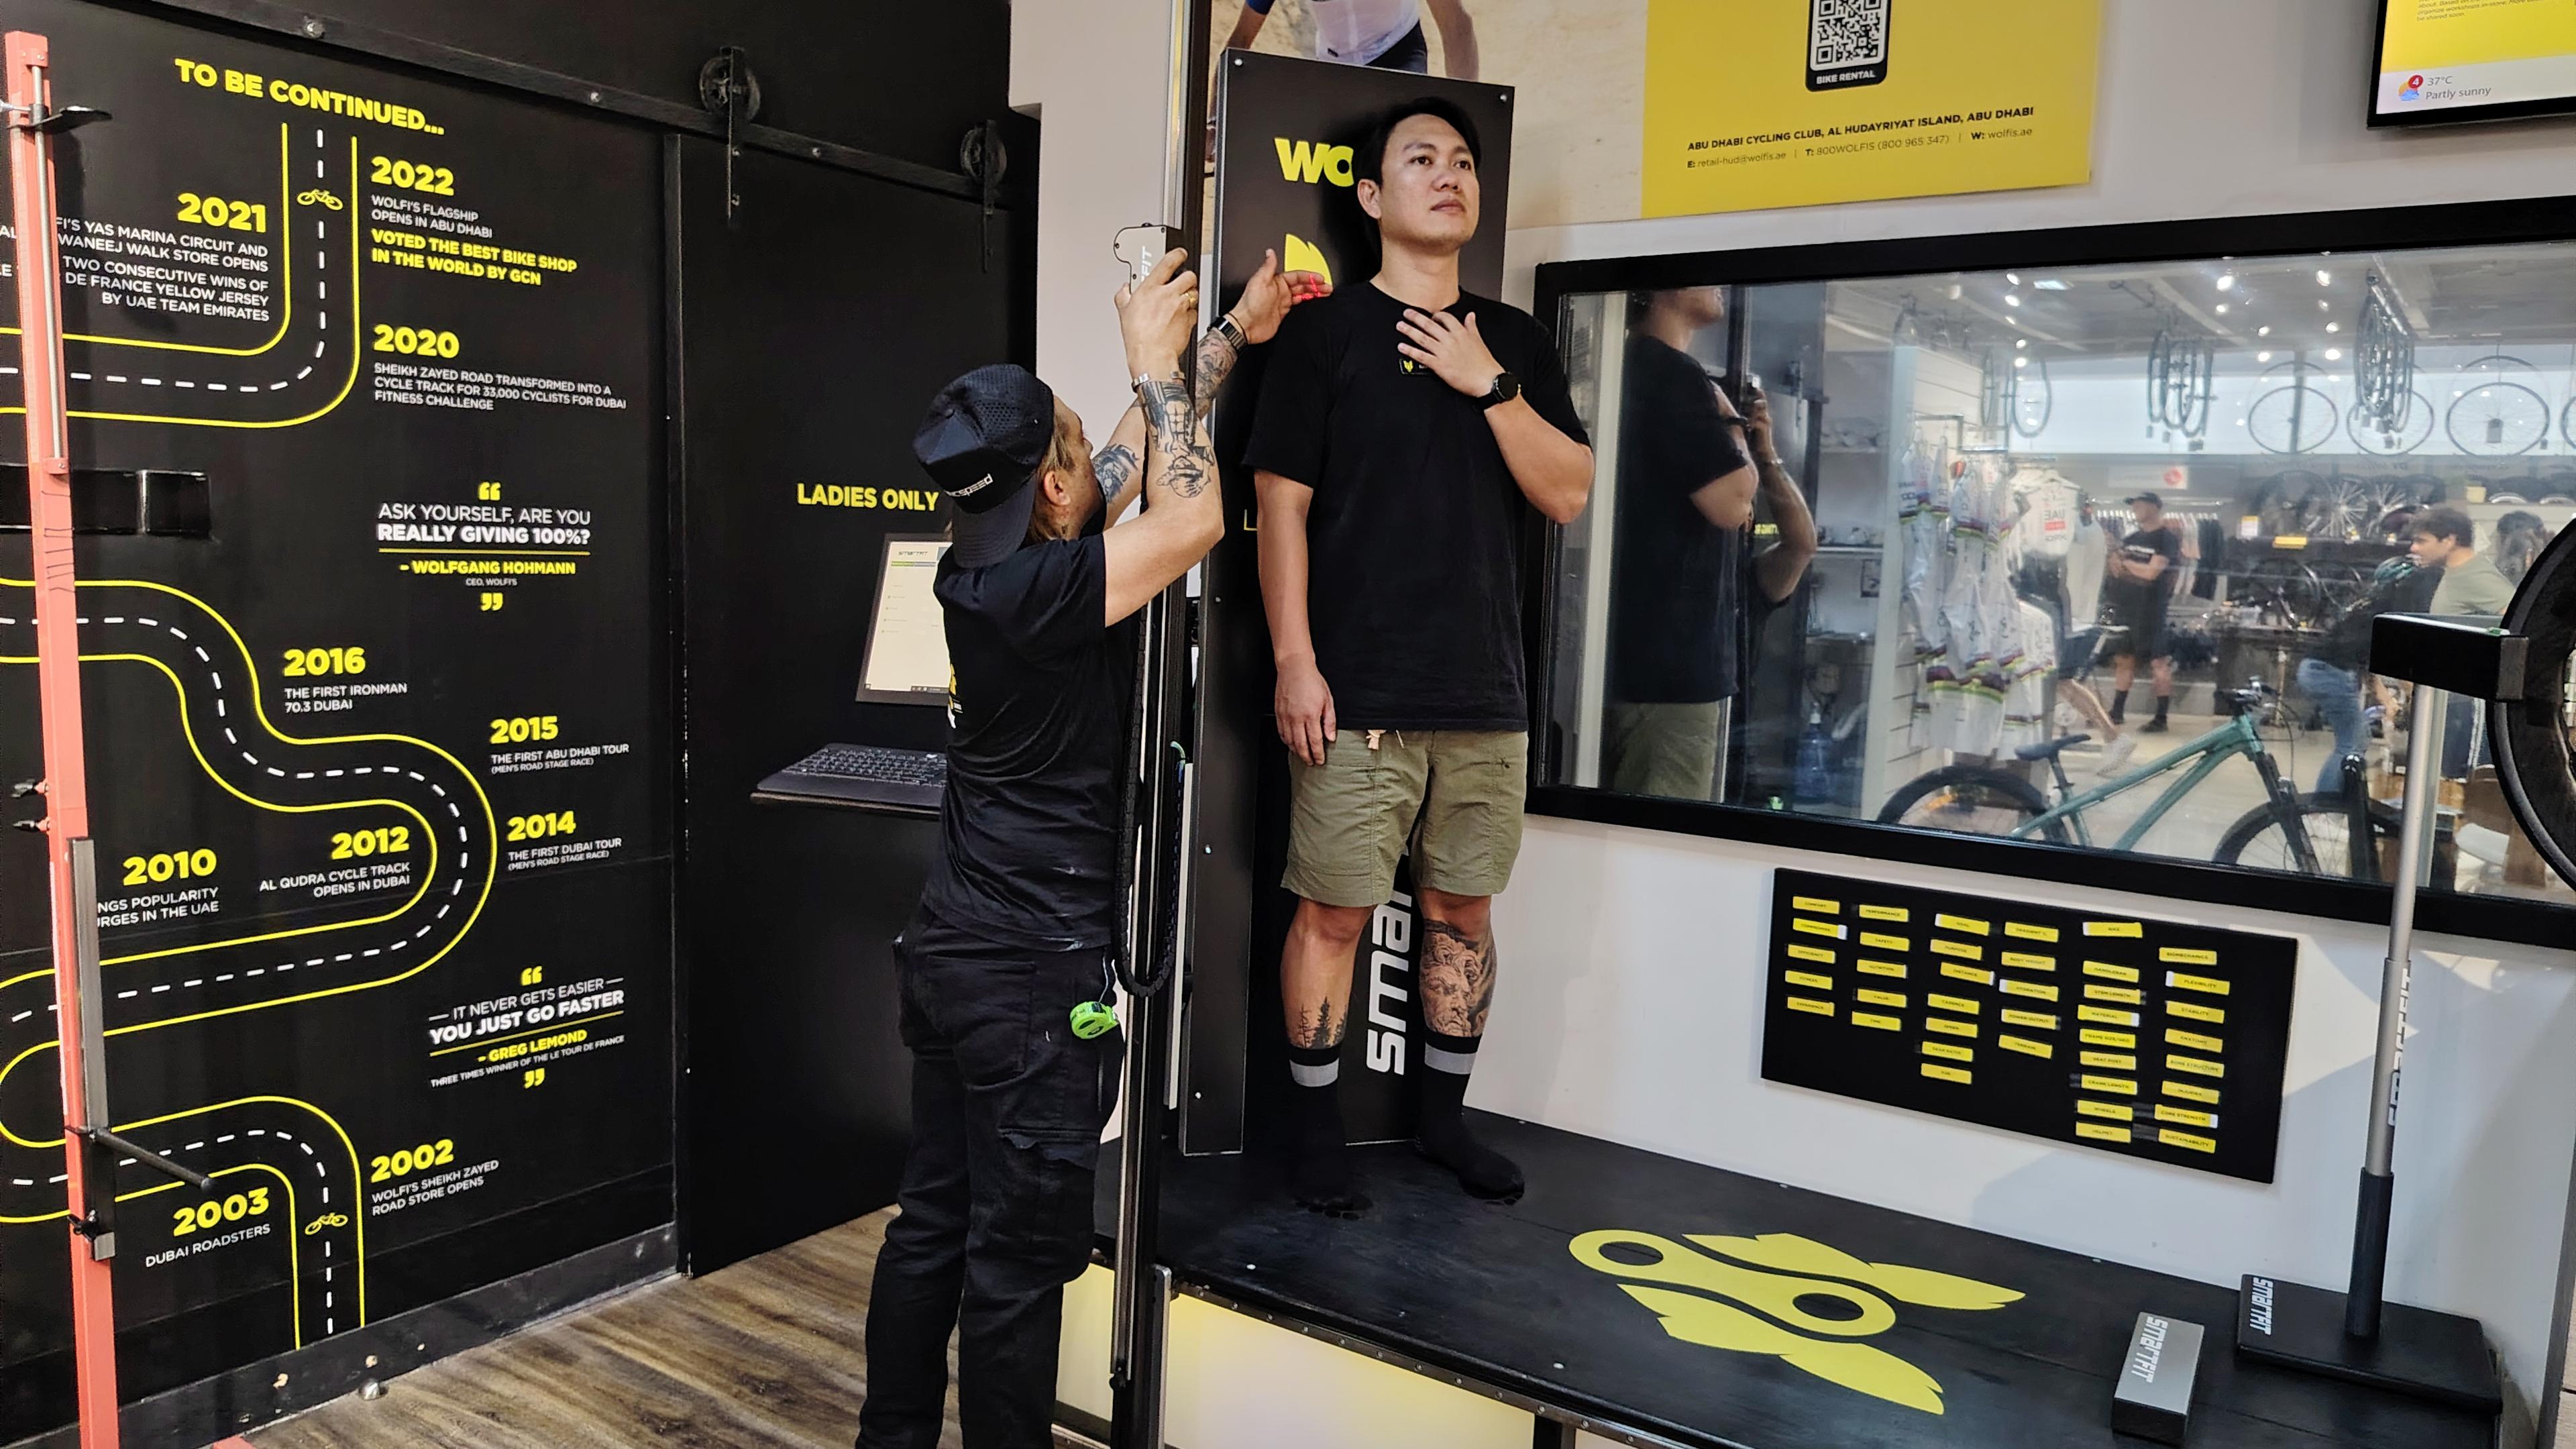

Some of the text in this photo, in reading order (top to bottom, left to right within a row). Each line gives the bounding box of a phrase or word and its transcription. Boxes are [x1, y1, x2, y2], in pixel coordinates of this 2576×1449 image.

[1816, 70, 1876, 85] BIKE RENTAL
[2426, 86, 2491, 101] Partly sunny
[2427, 75, 2453, 87] 37°C
[174, 58, 444, 135] TO BE CONTINUED...
[1687, 107, 2034, 151] ABU DHABI CYCLING CLUB, AL HUDAYRIYAT ISLAND, ABU DHABI
[1686, 160, 1696, 168] E:
[1805, 148, 1814, 156] T:
[1817, 142, 1875, 156] 800WOLFIS
[1878, 139, 1902, 151] (800
[1905, 138, 1924, 147] 965
[1927, 134, 1949, 145] 347)
[1971, 131, 1985, 140] W:
[1988, 128, 2033, 139] wolfis.ae
[371, 156, 454, 196] 2022
[177, 193, 266, 233] 2021
[371, 194, 479, 222] WOLFI'S FLAGSHIP
[371, 209, 492, 238] OPENS IN ABU DHABI
[84, 220, 115, 236] YAS
[117, 225, 177, 245] MARINA
[180, 235, 235, 253] CIRCUIT
[237, 243, 268, 258] AND
[371, 228, 577, 272] VOTED THE BEST BIKE SHOP
[62, 255, 268, 292] TWO CONSECUTIVE WINS OF
[372, 248, 541, 286] IN THE WORLD BY GCN
[65, 272, 269, 307] DE FRANCE YELLOW JERSEY
[101, 291, 270, 322] BY UAE TEAM EMIRATES
[374, 324, 460, 358] 2020
[374, 362, 612, 395] SHEIKH ZAYED ROAD TRANSFORMED INTO A
[374, 376, 413, 390] CYCLE
[415, 379, 455, 394] TRACK
[456, 383, 481, 396] FOR
[521, 389, 570, 405] CYCLISTS
[572, 394, 594, 406] FOR
[595, 396, 627, 409] DUBAI
[374, 390, 494, 411] FITNESS CHALLENGE
[378, 502, 590, 525] ASK YOURSELF, ARE YOU
[798, 483, 939, 511] LADIES ONLY
[377, 523, 590, 545] REALLY GIVING 100%?
[411, 560, 576, 574] WOLFGANG HOHMANN
[284, 647, 366, 677] 2016
[284, 683, 407, 699] THE FIRST IRONMAN
[284, 699, 353, 713] 70.3 DUBAI
[490, 715, 559, 744] 2015
[491, 743, 629, 764] THE FIRST ABU DHABI TOUR
[507, 810, 576, 842] 2014
[331, 826, 409, 860] 2012
[123, 849, 217, 886] 2010
[131, 887, 219, 909] POPULARITY
[453, 977, 604, 1020] IT NEVER GETS EASIER
[429, 989, 624, 1044] YOU JUST GO FASTER
[430, 1034, 625, 1087] THREE TIMES WINNER OF THE LE TOUR DE FRANCE
[488, 1029, 588, 1062] GREG LEMOND
[371, 1139, 453, 1183] 2002
[372, 1160, 499, 1203] WOLFI'S SHEIKH ZAYED
[372, 1175, 484, 1216] ROAD STORE OPENS
[173, 1187, 269, 1237] 2003
[146, 1223, 270, 1268] DUBAI ROADSTERS
